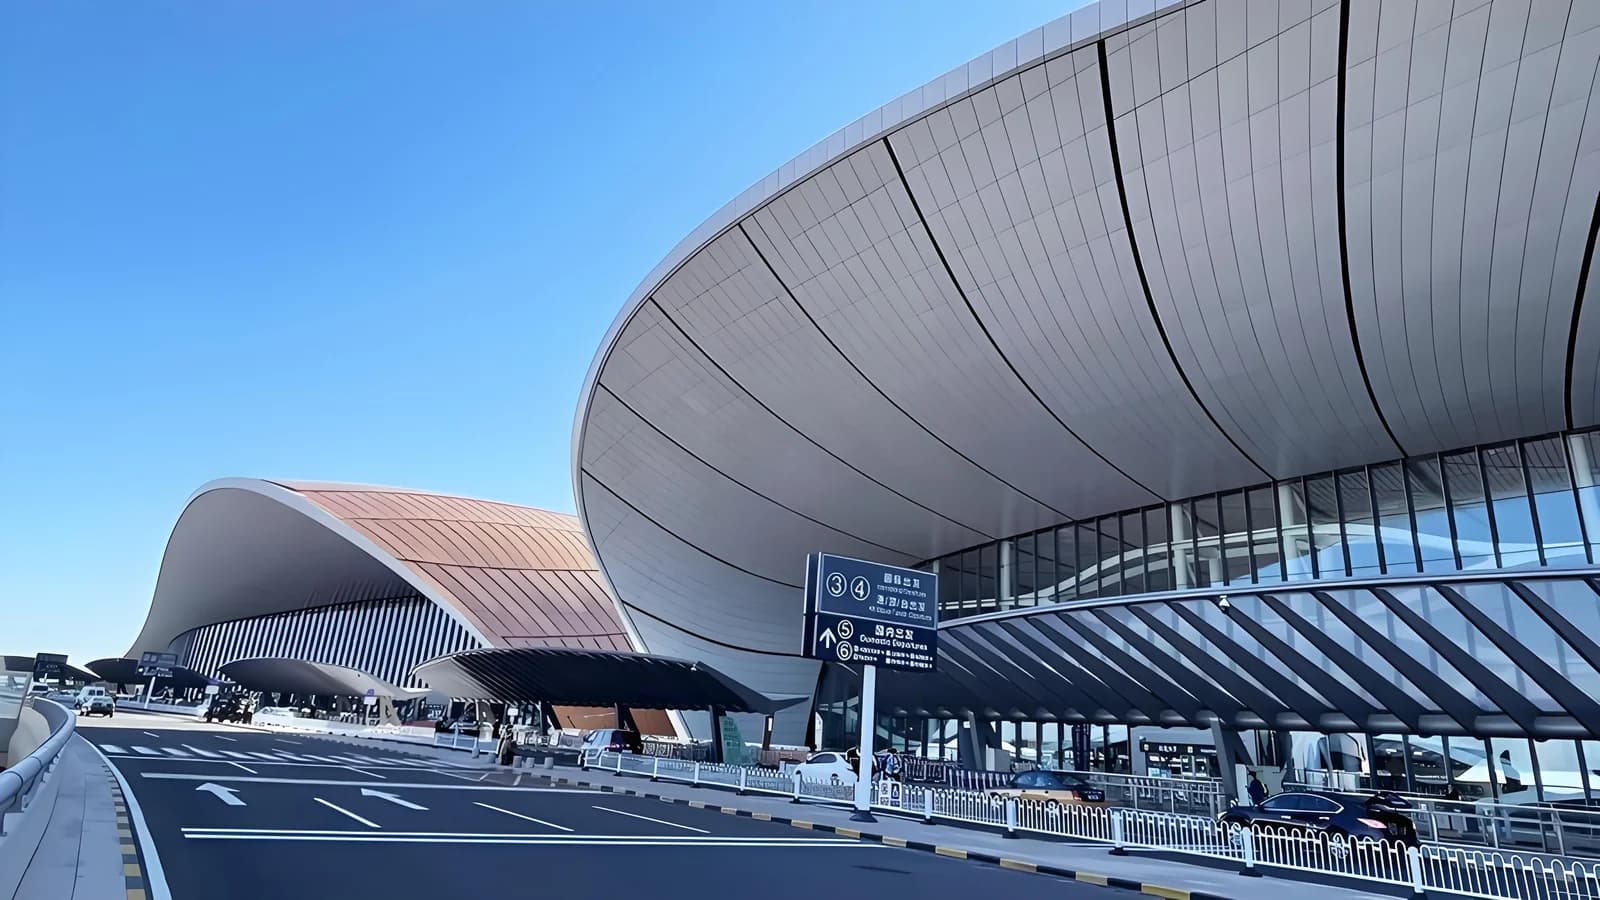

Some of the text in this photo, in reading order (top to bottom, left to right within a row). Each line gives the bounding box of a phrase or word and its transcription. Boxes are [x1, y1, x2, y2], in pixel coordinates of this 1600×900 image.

[831, 575, 842, 594] 3
[854, 579, 865, 598] 4
[841, 622, 850, 636] 5
[840, 643, 849, 658] 6
